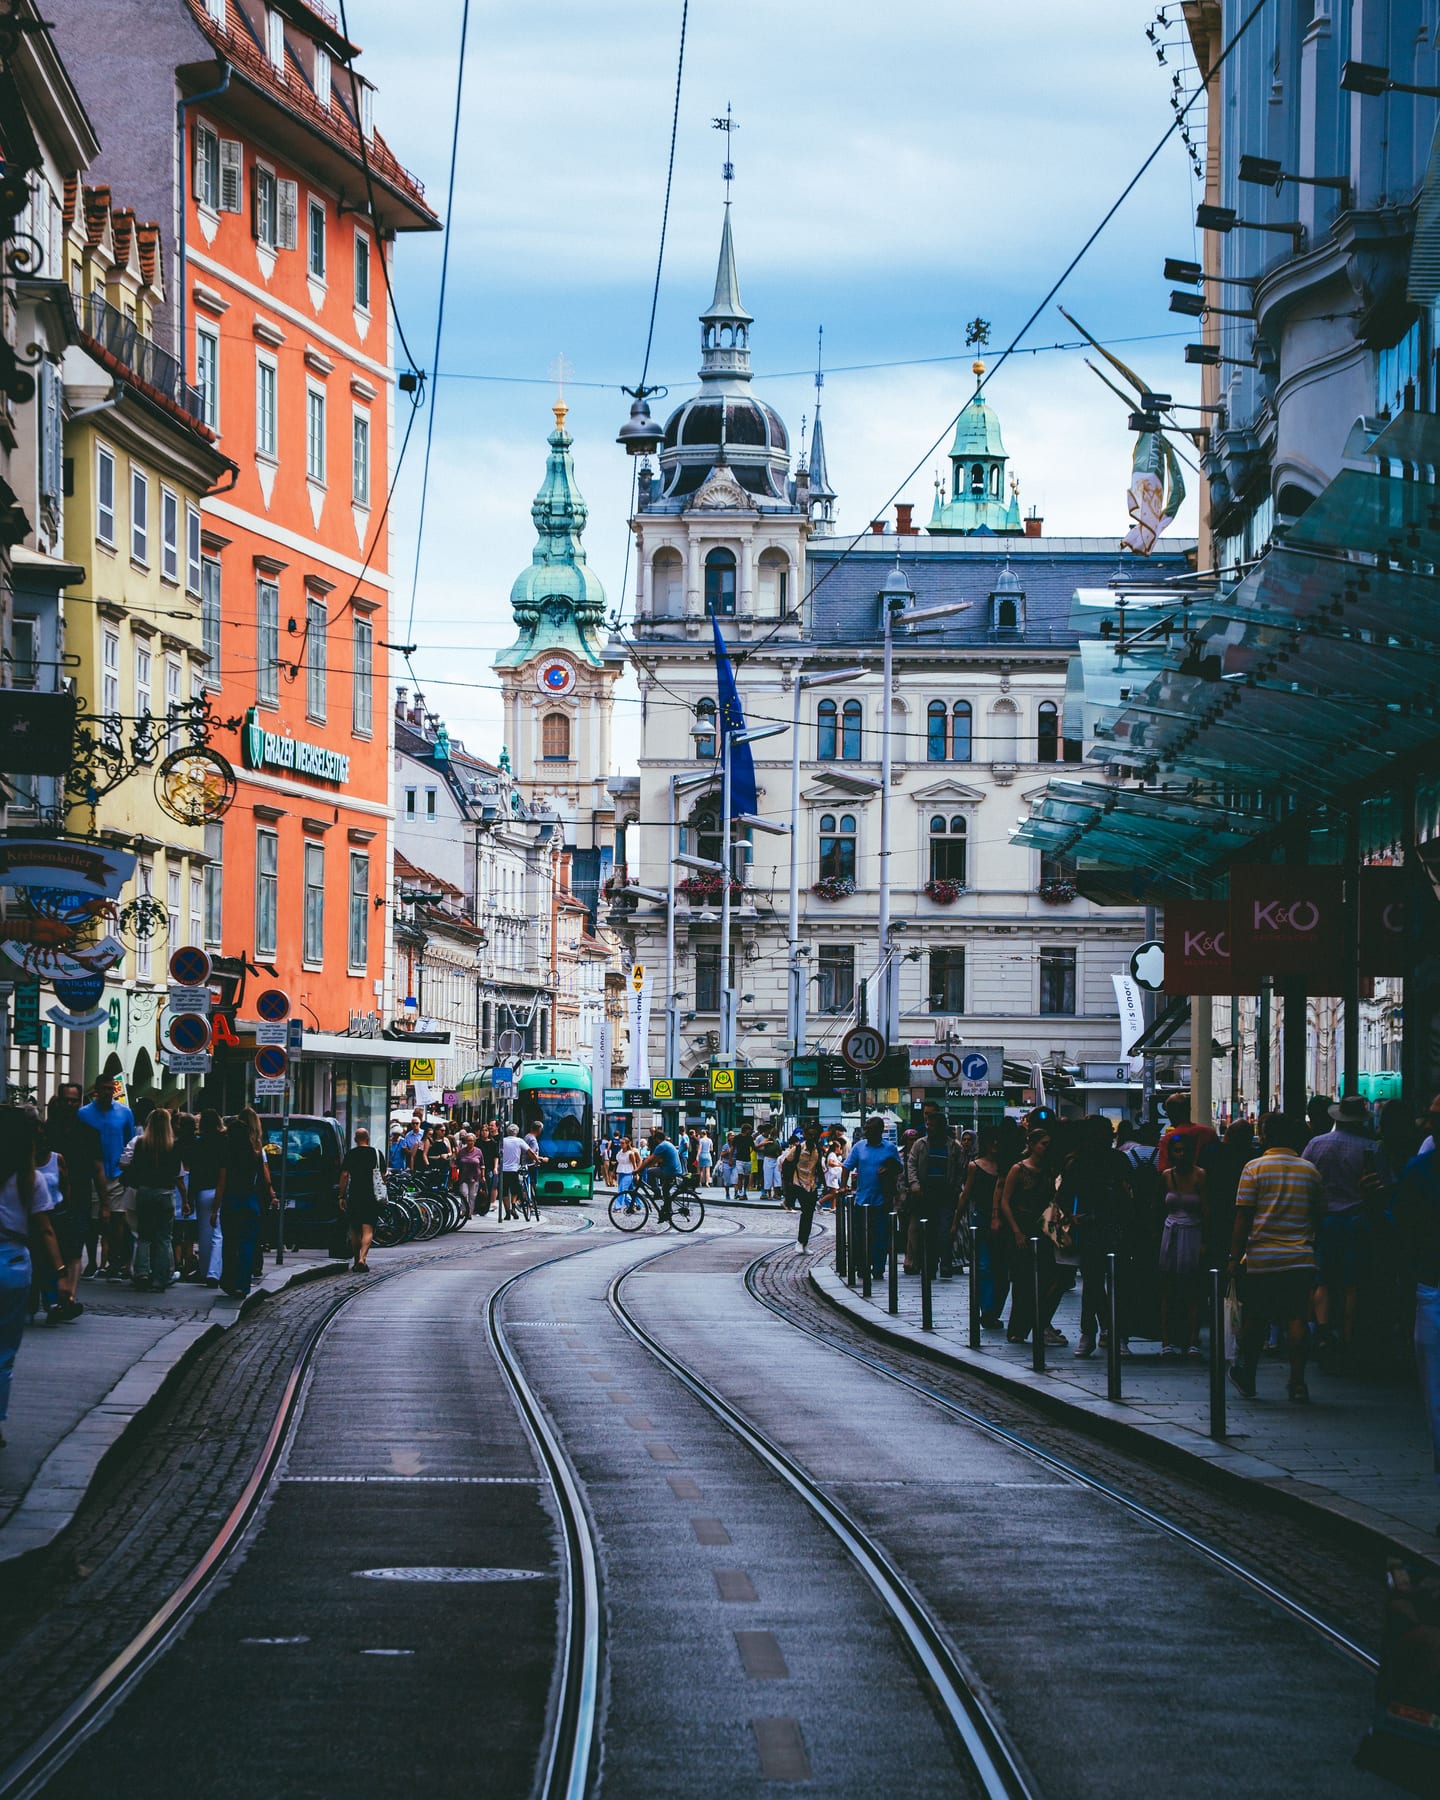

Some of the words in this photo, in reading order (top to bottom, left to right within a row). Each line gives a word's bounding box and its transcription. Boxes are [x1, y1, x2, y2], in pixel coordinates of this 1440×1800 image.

[264, 731, 295, 768] GRAZER
[295, 740, 350, 784] WECHSELSEITIGE
[7, 849, 92, 867] Krebsenkeller
[1254, 900, 1319, 931] K&O
[852, 1036, 876, 1059] 20
[1116, 1068, 1124, 1079] 8
